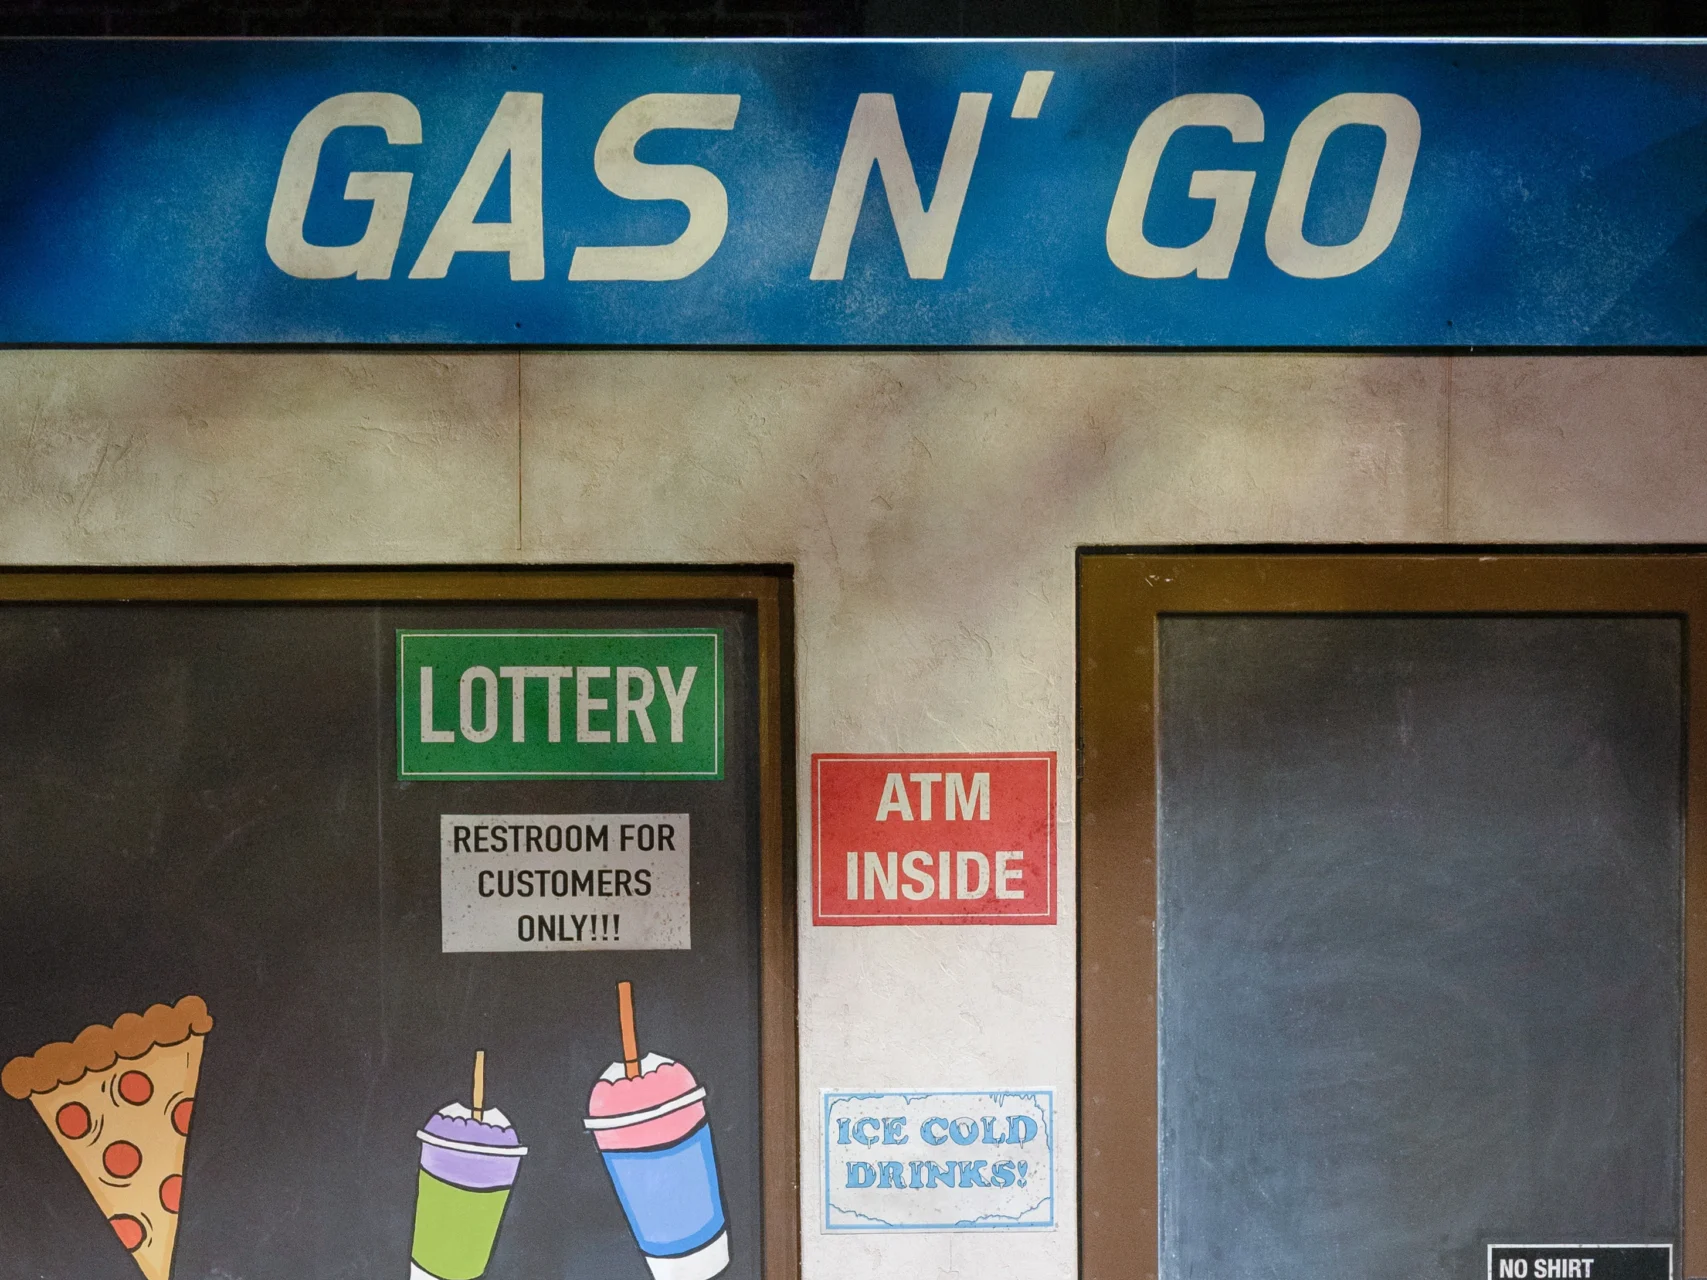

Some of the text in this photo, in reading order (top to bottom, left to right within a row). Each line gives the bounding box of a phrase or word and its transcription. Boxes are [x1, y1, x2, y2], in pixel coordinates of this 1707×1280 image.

[265, 70, 1422, 281] GAS N' GO
[420, 665, 699, 743] LOTTERY
[875, 772, 991, 821] ATM
[453, 823, 676, 853] RESTROOM FOR
[478, 869, 653, 898] CUSTOMERS
[846, 851, 1025, 900] INSIDE
[517, 914, 621, 942] ONLY!!!
[836, 1115, 1039, 1148] ICE COLD
[845, 1160, 1029, 1189] DRINKS!
[1499, 1258, 1595, 1279] NO SHIRT
